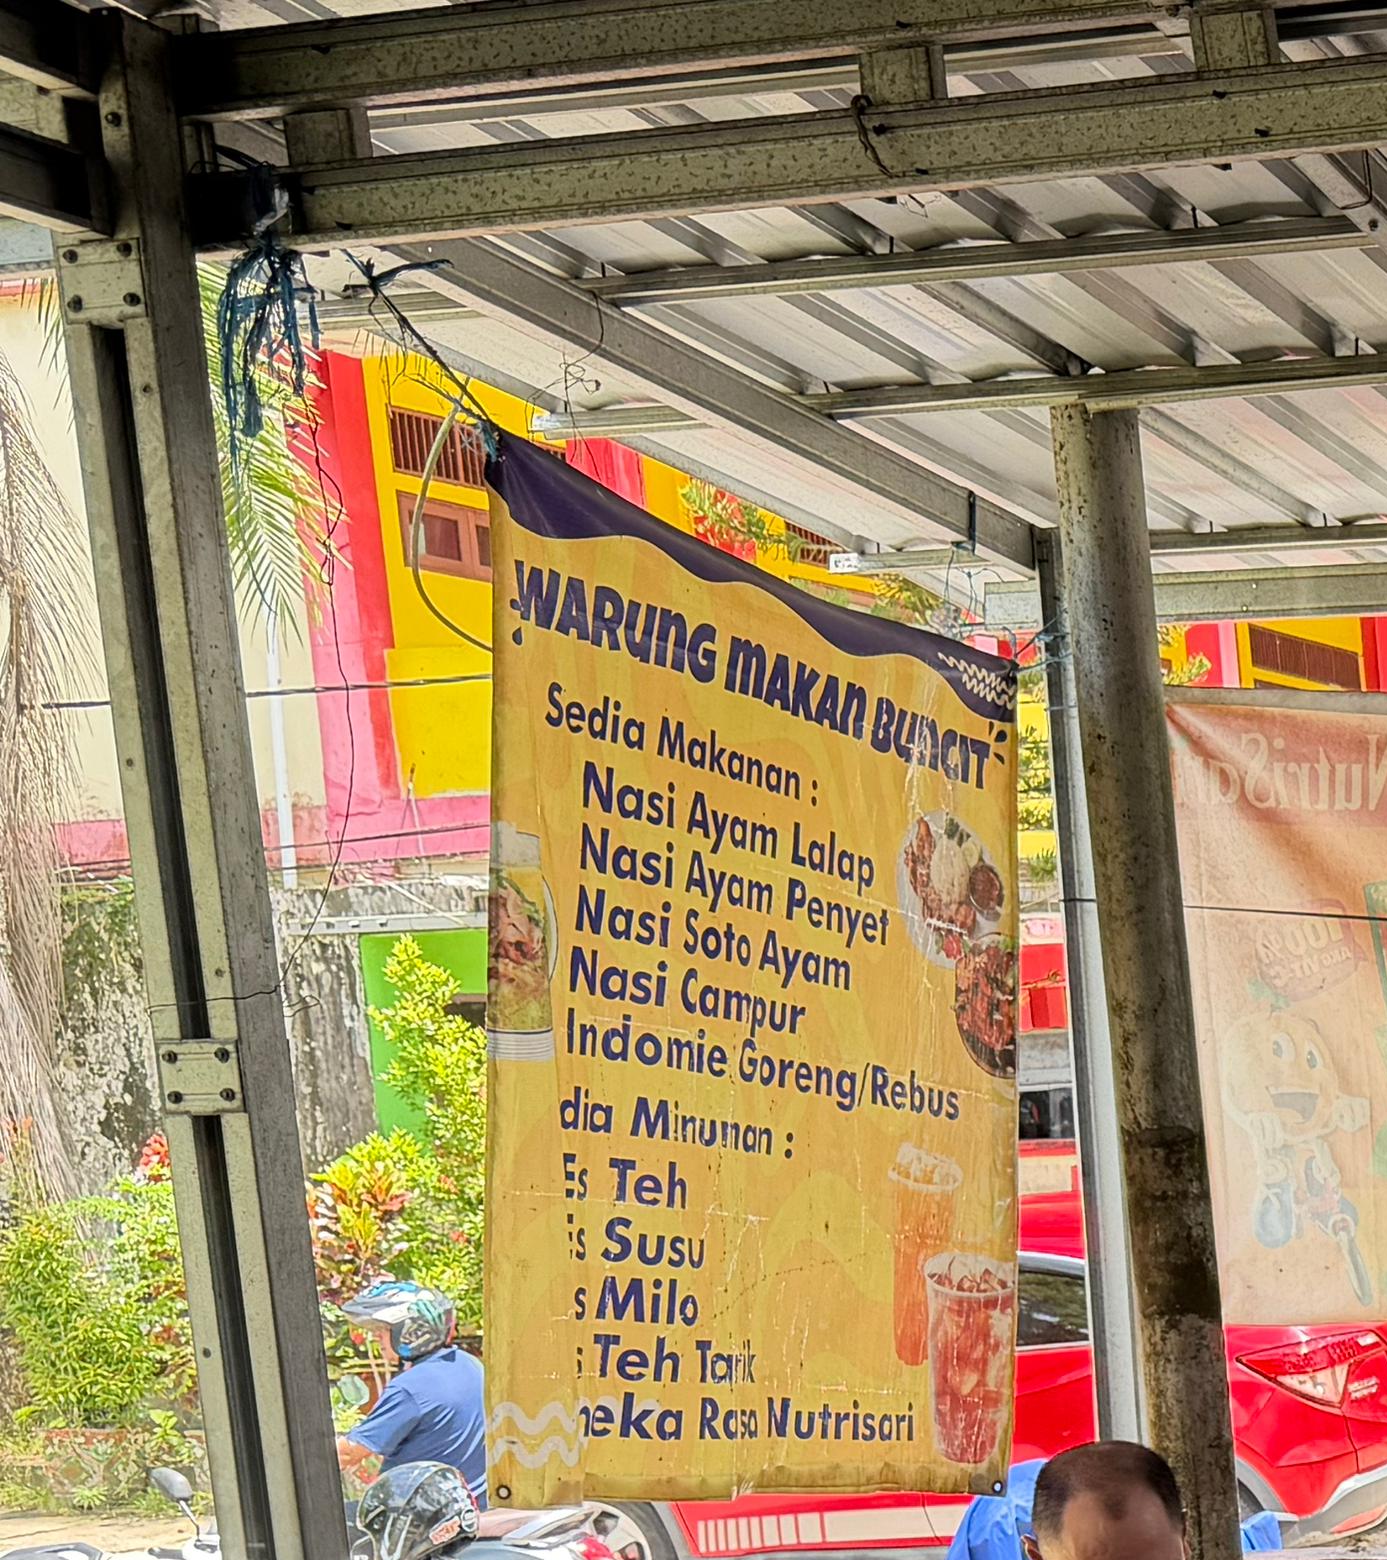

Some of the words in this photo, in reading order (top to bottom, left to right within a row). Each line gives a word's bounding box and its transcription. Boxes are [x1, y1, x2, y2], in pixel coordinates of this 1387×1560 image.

[514, 559, 716, 684] WARUNG
[724, 634, 866, 742] MAKAN
[870, 696, 990, 791] BUNCIT
[545, 681, 645, 753] Sedia
[656, 715, 801, 801] Makanan
[582, 761, 675, 829] Nasi
[686, 792, 779, 857] Ayam
[790, 822, 875, 898] Lalap
[579, 822, 674, 890] Nasi
[685, 851, 774, 916] Ayam
[787, 878, 891, 950] Penyet
[575, 885, 670, 949] Nasi
[683, 909, 751, 967] Soto
[758, 929, 852, 992] Ayam
[568, 945, 668, 1009] Nasi
[680, 968, 807, 1040] Campur
[559, 1086, 614, 1134] dia
[565, 1008, 728, 1080] Indomie
[737, 1039, 961, 1122] Goreng/Rebus
[608, 1157, 688, 1210] Teh
[600, 1216, 706, 1271] Susu
[594, 1275, 700, 1328] Milo
[593, 1333, 682, 1384] Teh
[578, 1392, 683, 1442] neka
[698, 1396, 759, 1441] Rasa
[767, 1396, 915, 1443] Nutrisari
